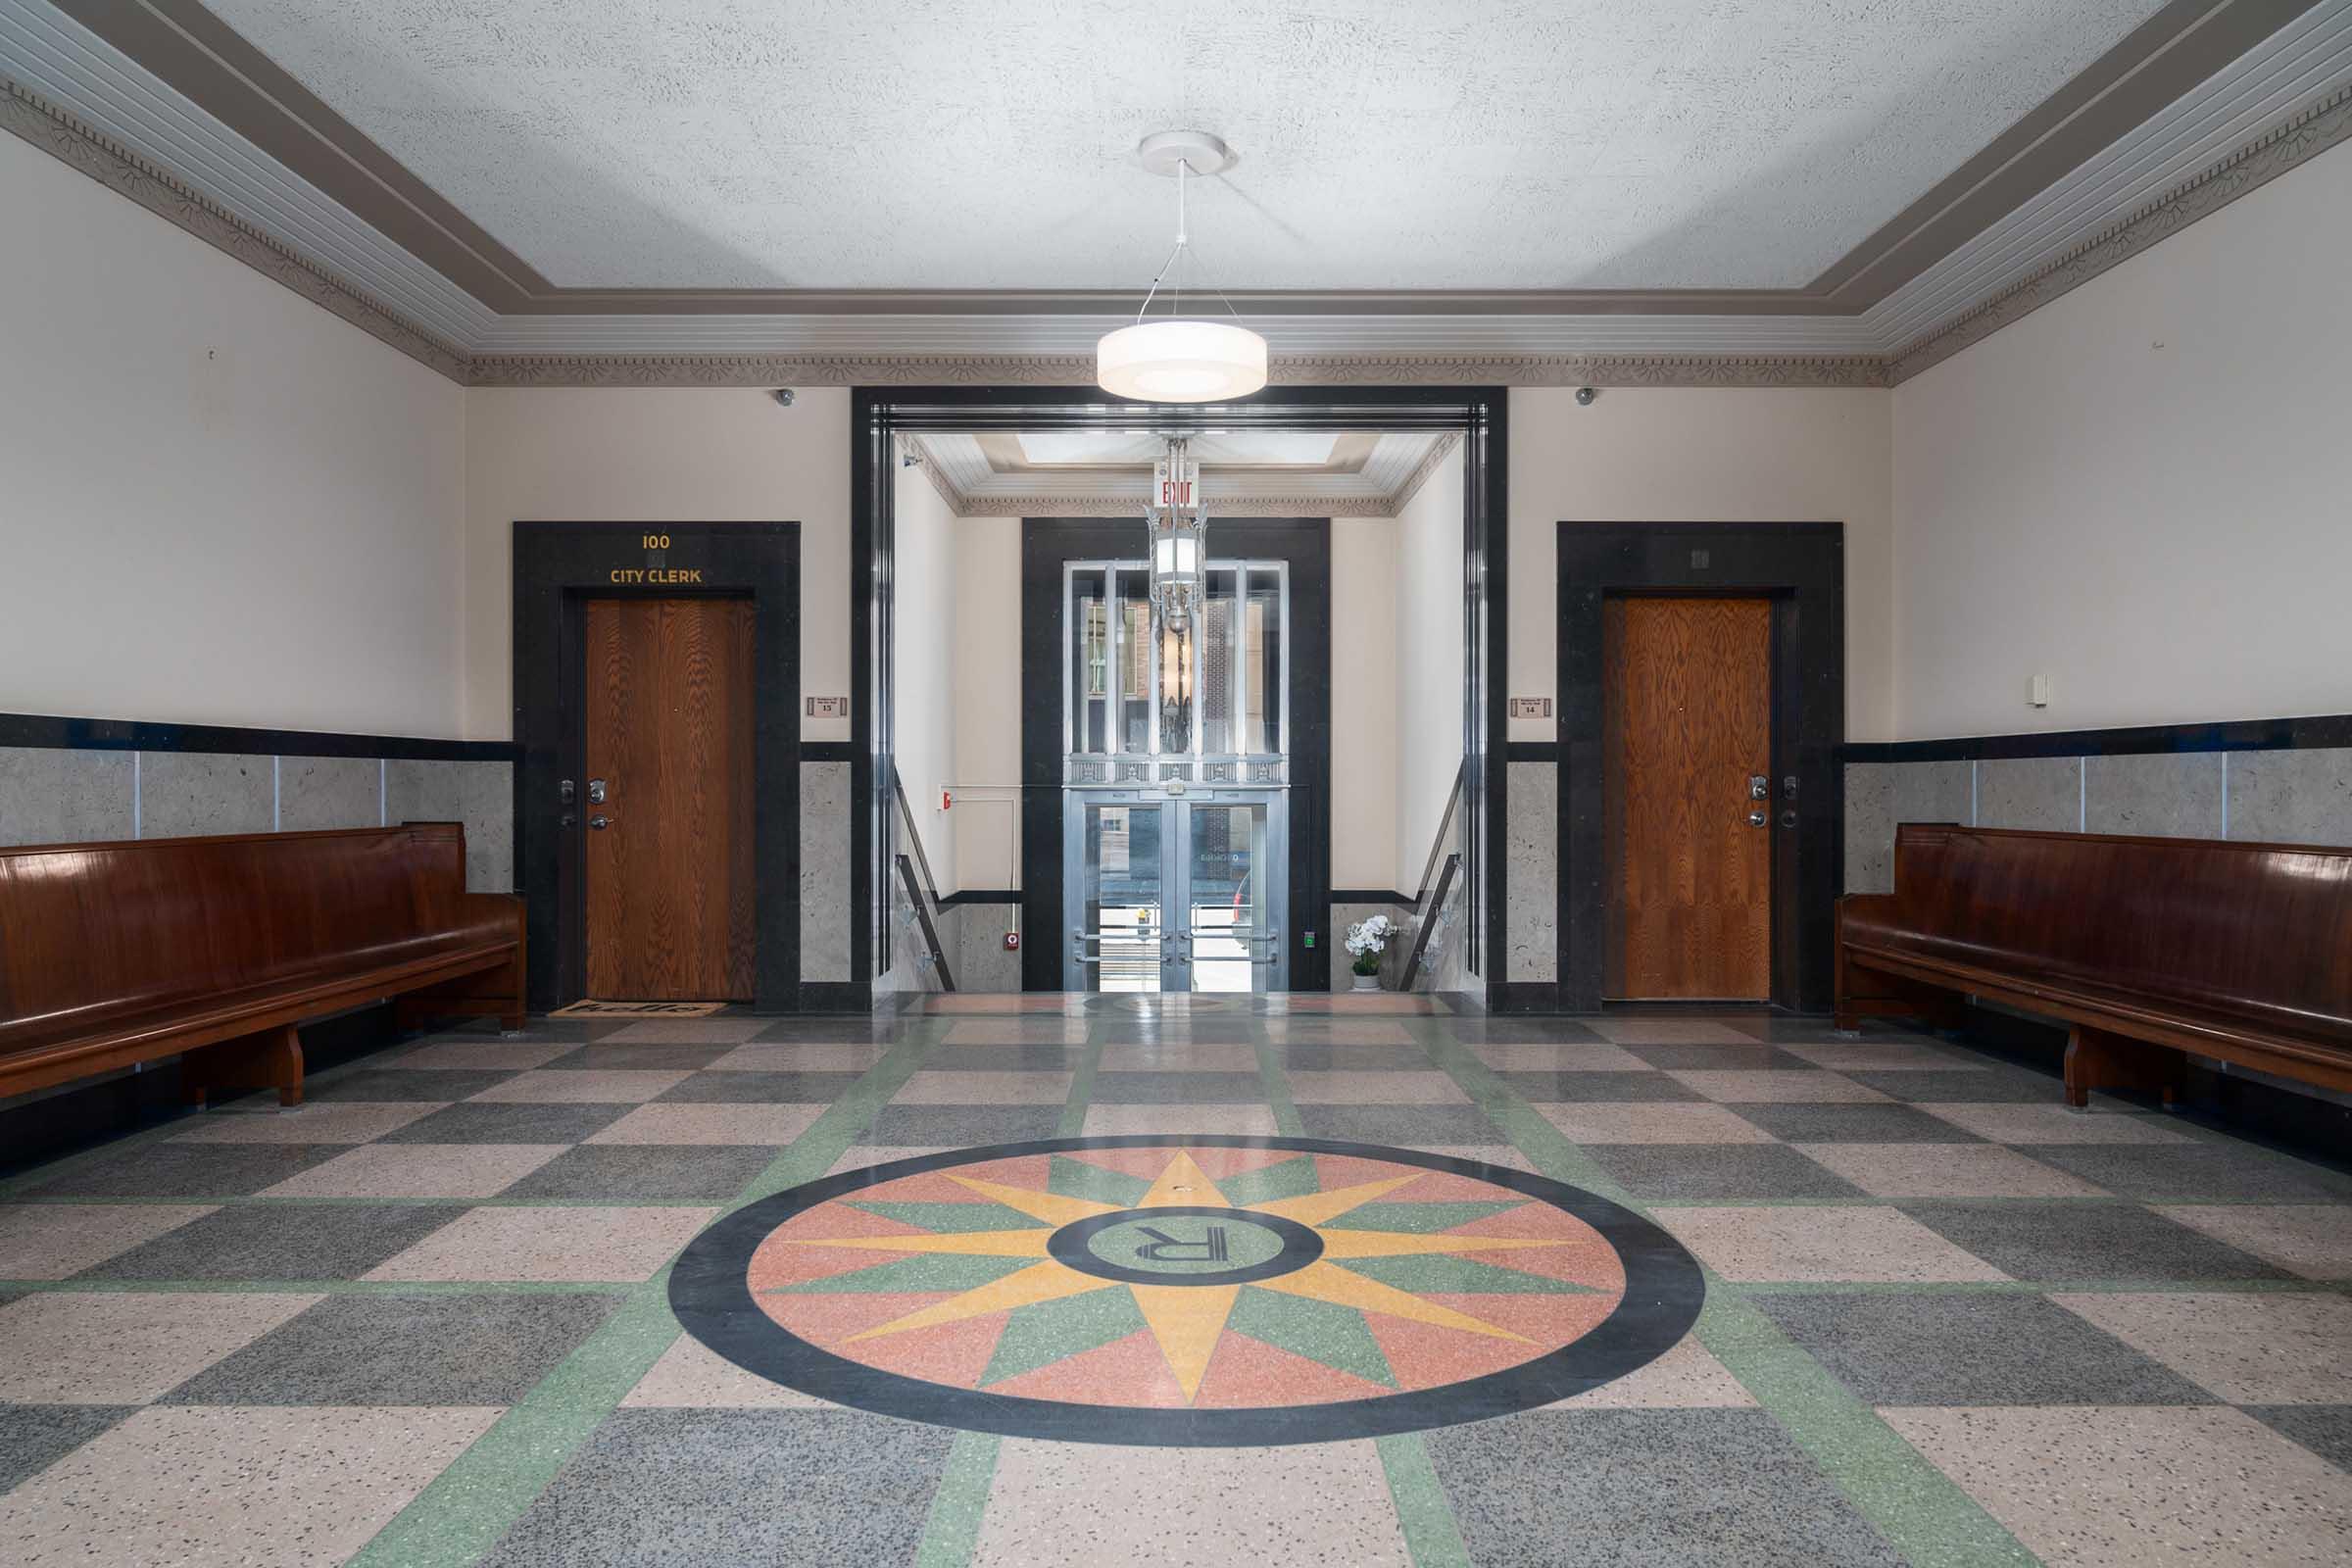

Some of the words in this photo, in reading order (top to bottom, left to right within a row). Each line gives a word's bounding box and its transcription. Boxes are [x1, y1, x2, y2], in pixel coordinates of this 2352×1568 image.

[643, 535, 670, 549] 100
[611, 570, 644, 583] CITY
[649, 570, 702, 583] CLERK
